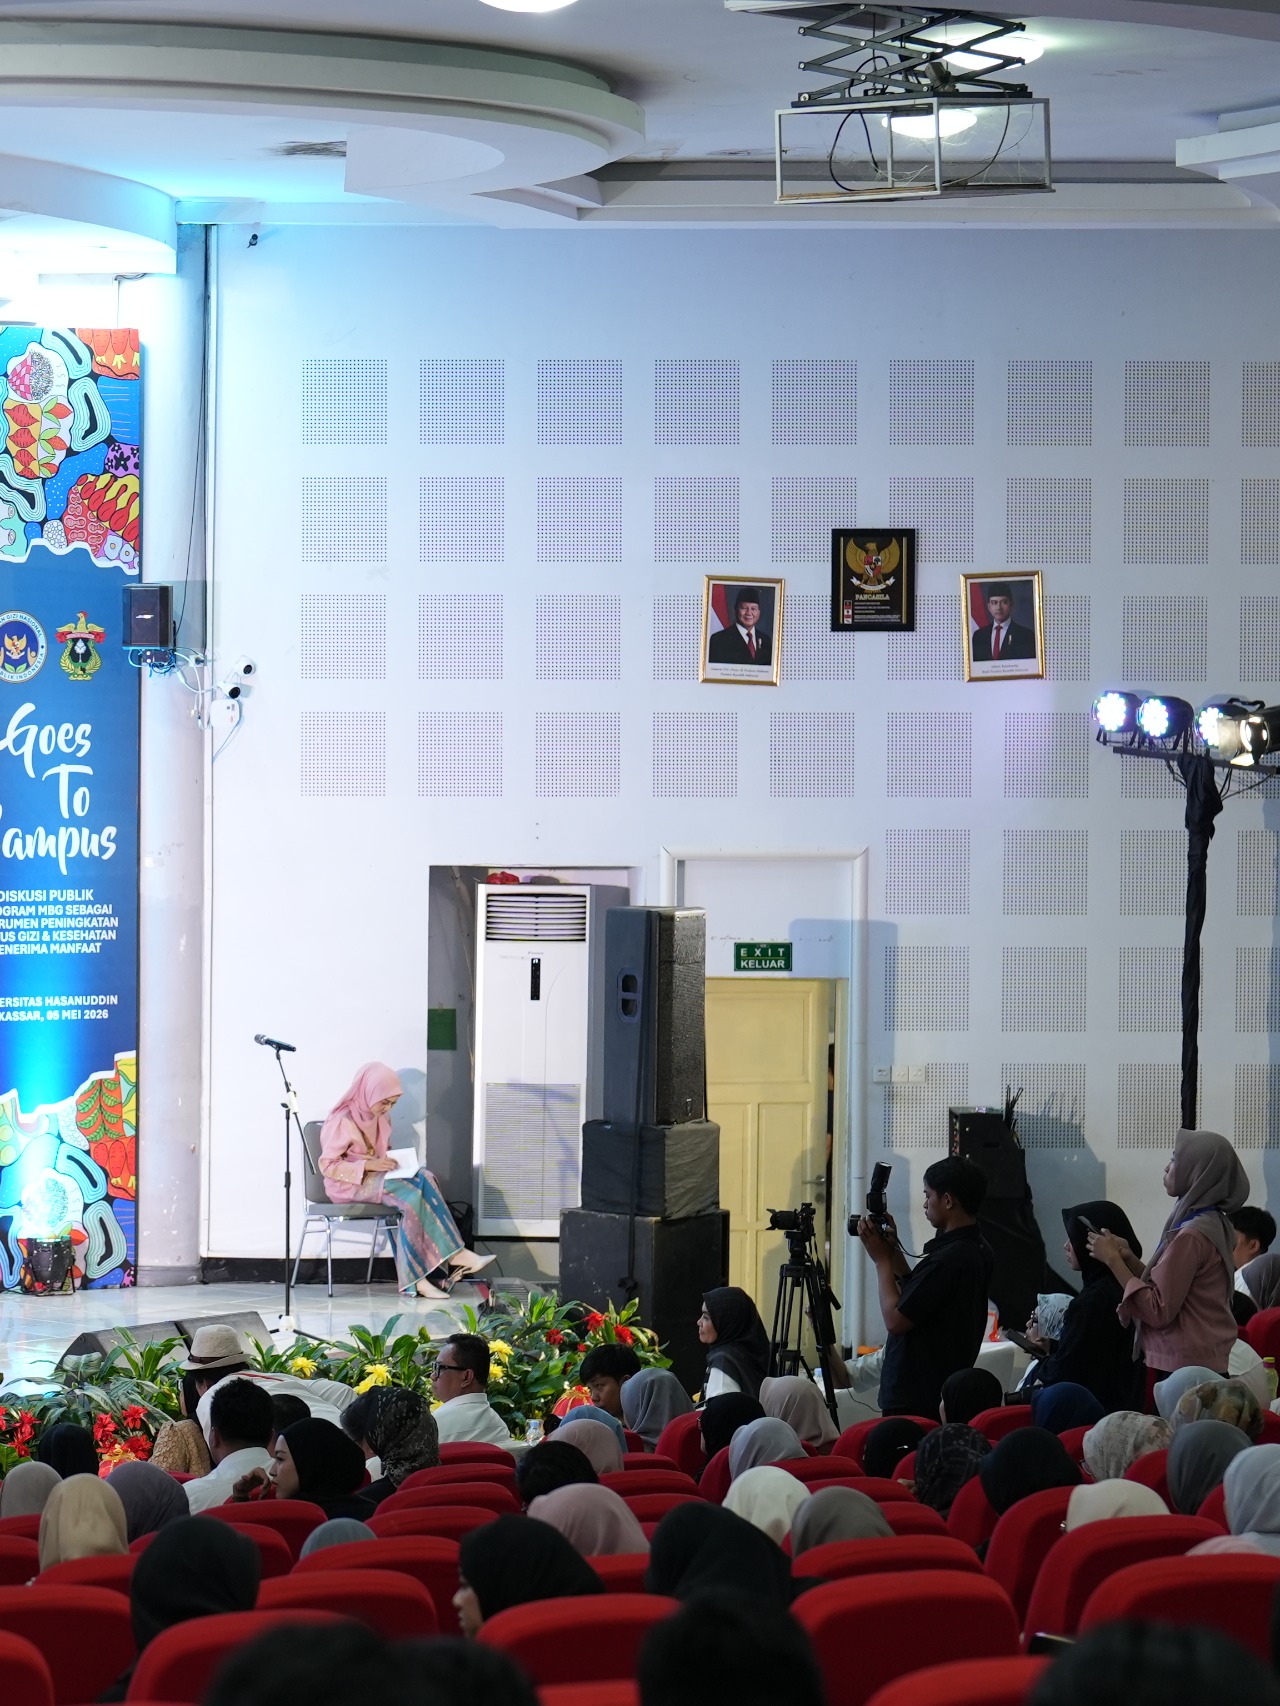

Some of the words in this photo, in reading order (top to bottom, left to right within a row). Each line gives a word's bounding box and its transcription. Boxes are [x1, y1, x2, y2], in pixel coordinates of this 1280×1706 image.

[42, 763, 94, 819] To
[49, 889, 94, 901] PUBLIK
[38, 904, 63, 916] MBG
[65, 904, 112, 915] SEBAGAI
[41, 917, 119, 928] PENINGKATAN
[18, 931, 40, 942] GIZI
[42, 930, 50, 942] &
[53, 930, 116, 942] KESEHATAN
[50, 942, 102, 954] MANFAAT
[740, 948, 785, 957] EXIT
[740, 959, 785, 969] KELUAR
[45, 995, 118, 1007] HASANUDDIN
[62, 1009, 81, 1020] MEI
[83, 1009, 109, 1020] 2026
